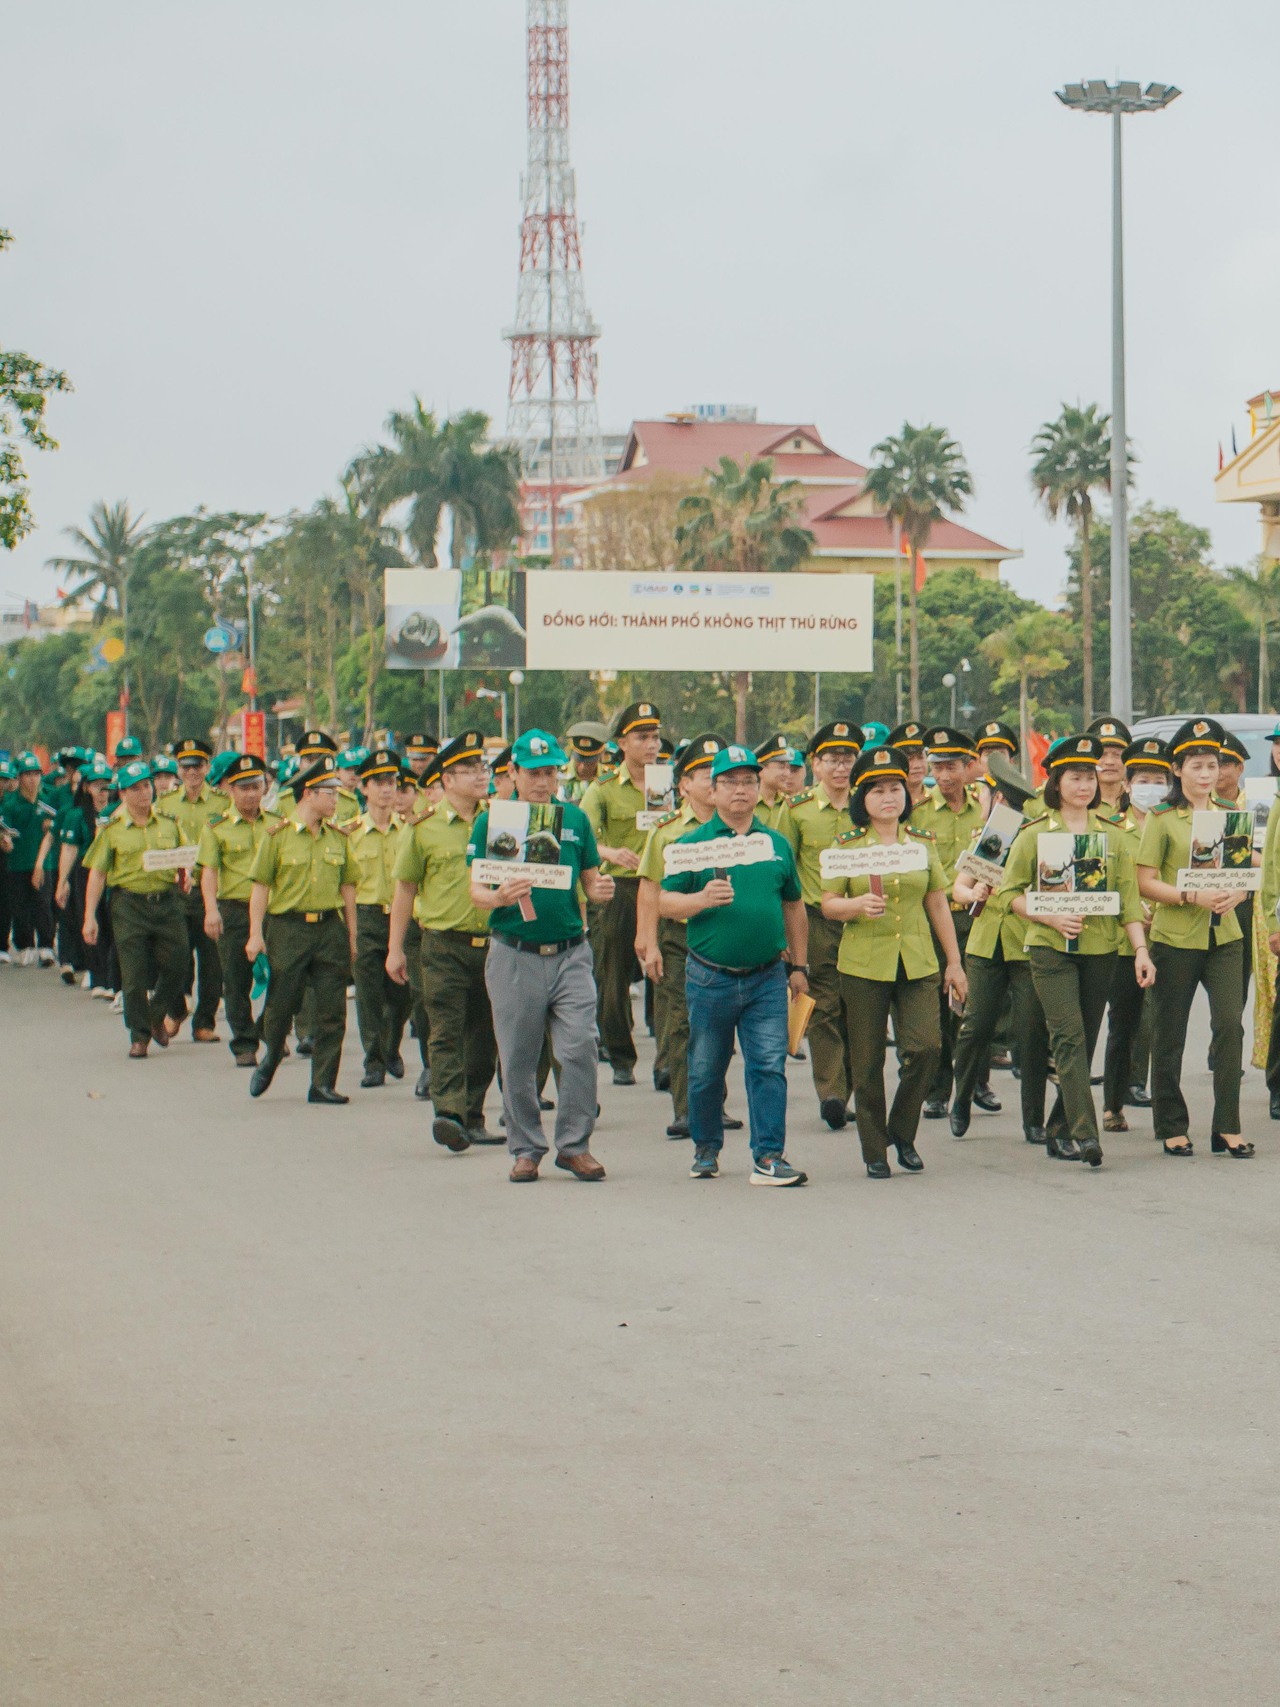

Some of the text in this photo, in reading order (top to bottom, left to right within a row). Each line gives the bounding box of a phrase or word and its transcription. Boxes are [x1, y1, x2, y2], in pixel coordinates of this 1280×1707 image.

[543, 610, 584, 626] ĐỒNG
[622, 611, 667, 628] THÀNH
[672, 612, 700, 628] PHỐ
[704, 612, 753, 629] KHÔNG
[758, 614, 786, 632] THỊT
[791, 613, 816, 630] THÚ
[820, 614, 857, 630] RỪNG
